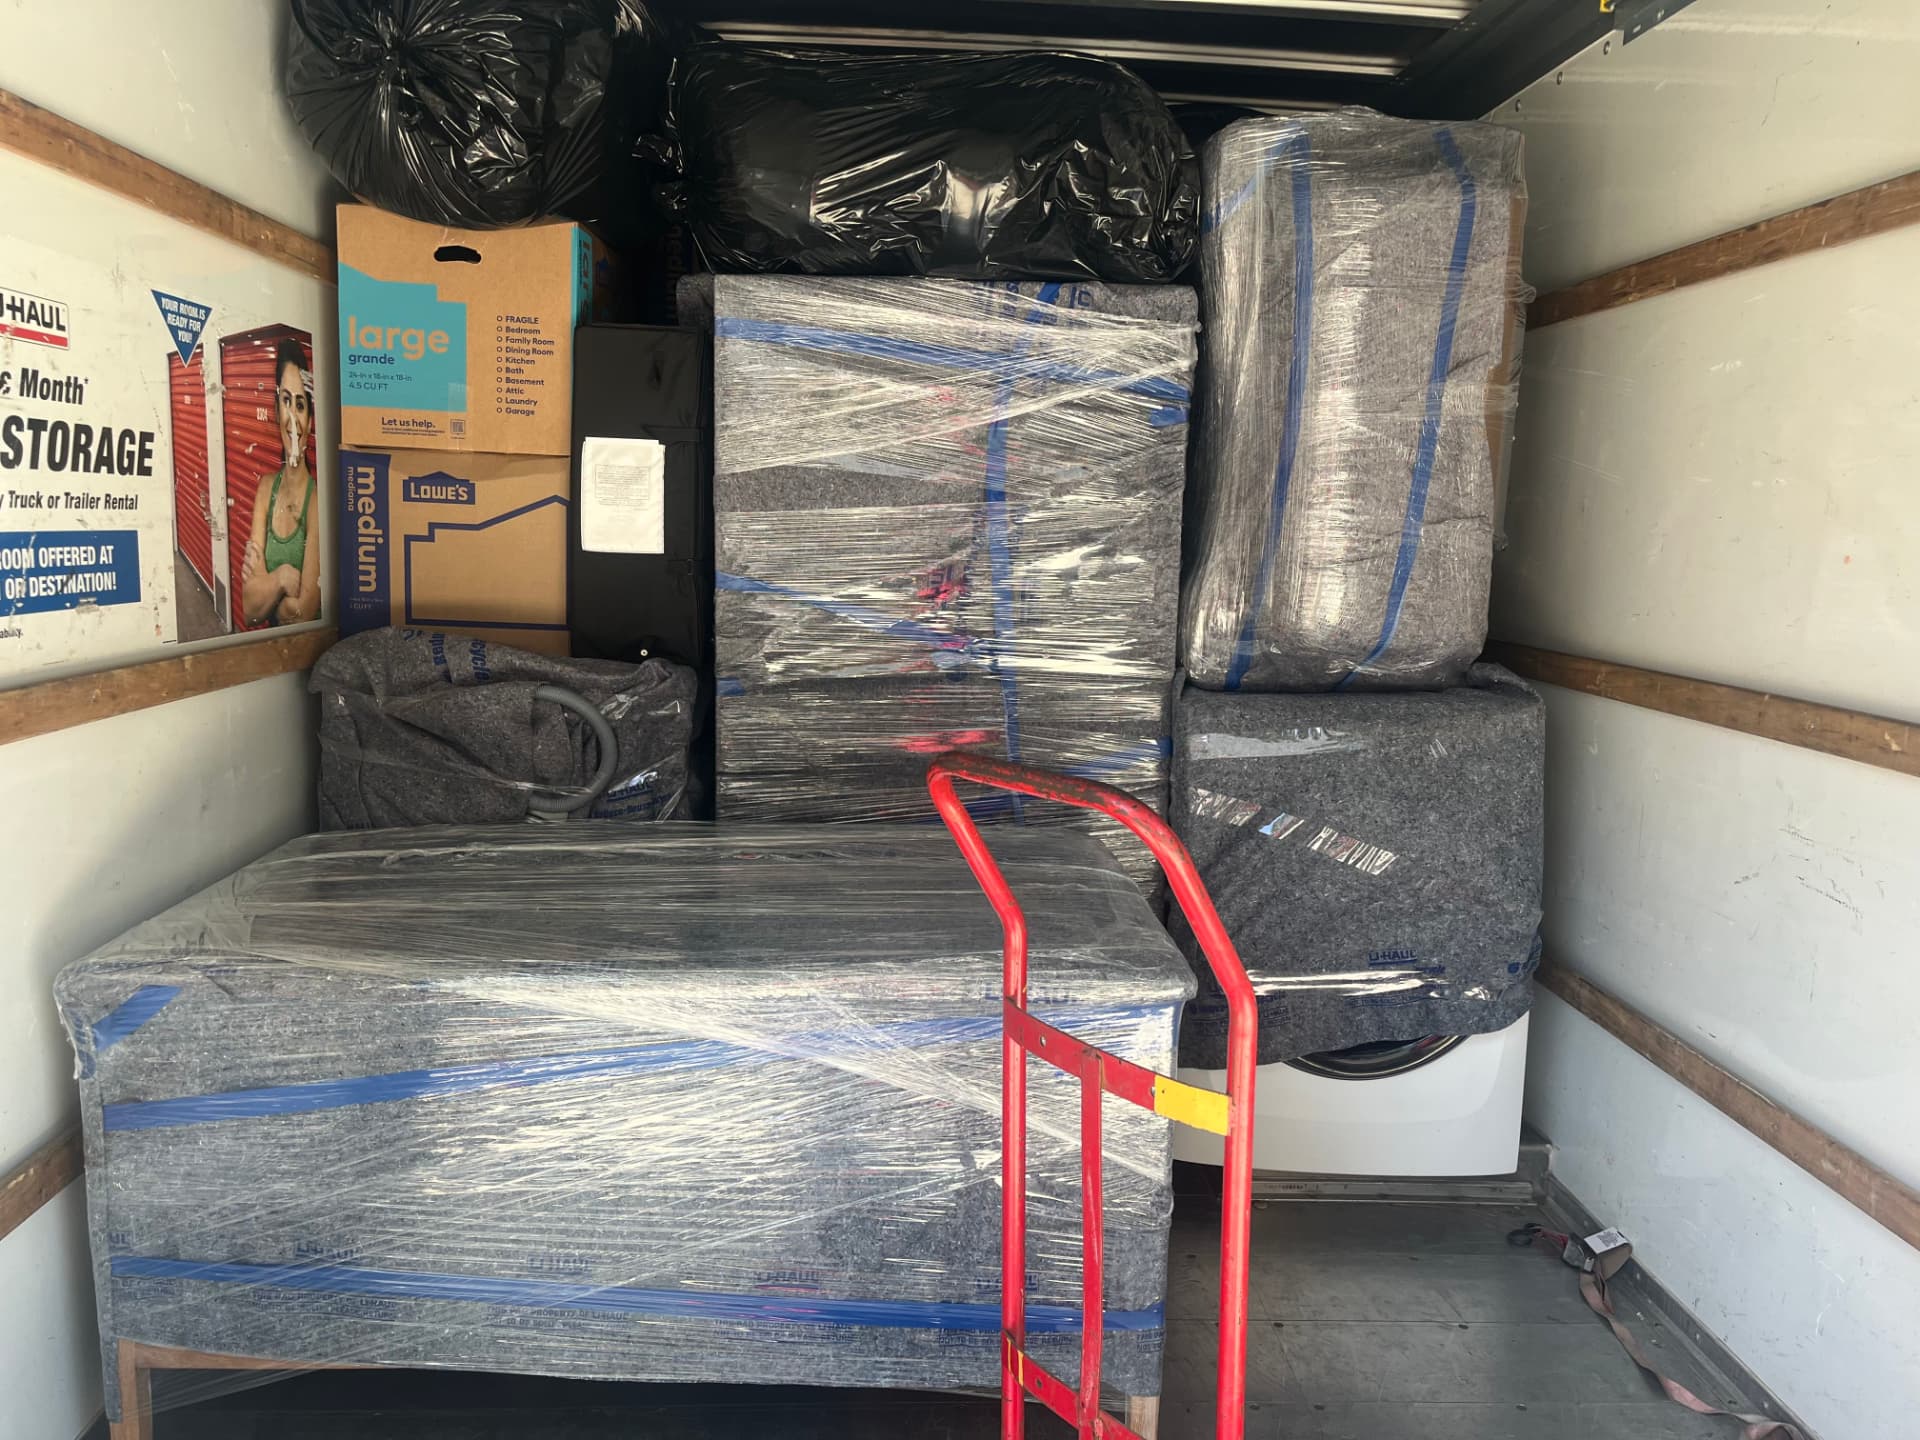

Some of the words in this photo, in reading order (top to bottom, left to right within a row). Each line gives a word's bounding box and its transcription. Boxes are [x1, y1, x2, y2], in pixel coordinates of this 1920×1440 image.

[0, 292, 66, 332] -HAUL
[161, 297, 178, 312] YOUR
[199, 309, 206, 320] IS
[167, 313, 187, 328] READY
[189, 319, 201, 333] FOR
[505, 315, 539, 324] FRAGILE
[348, 316, 449, 361] large
[505, 326, 540, 335] Bedroom
[505, 336, 531, 345] Family
[348, 352, 395, 365] grande
[505, 346, 531, 355] Dining
[505, 357, 535, 365] Kitchen
[363, 382, 377, 390] CU
[378, 383, 388, 392] FT
[505, 377, 544, 386] Basement
[505, 397, 537, 406] Laundry
[505, 407, 535, 416] Garage
[381, 417, 397, 426] Let
[412, 419, 436, 429] help.
[0, 415, 155, 477] STORAGE
[347, 466, 357, 511] mediano
[410, 482, 468, 501] LOWE'S
[8, 490, 43, 509] Truck
[47, 495, 60, 509] or
[64, 492, 100, 510] Trailer
[104, 493, 138, 510] Rental
[357, 466, 384, 592] medium
[0, 547, 35, 570] OOM
[39, 545, 96, 568] OFFERED
[100, 545, 114, 565] AT
[5, 577, 25, 600] OR
[29, 571, 117, 598] DESTINATION!
